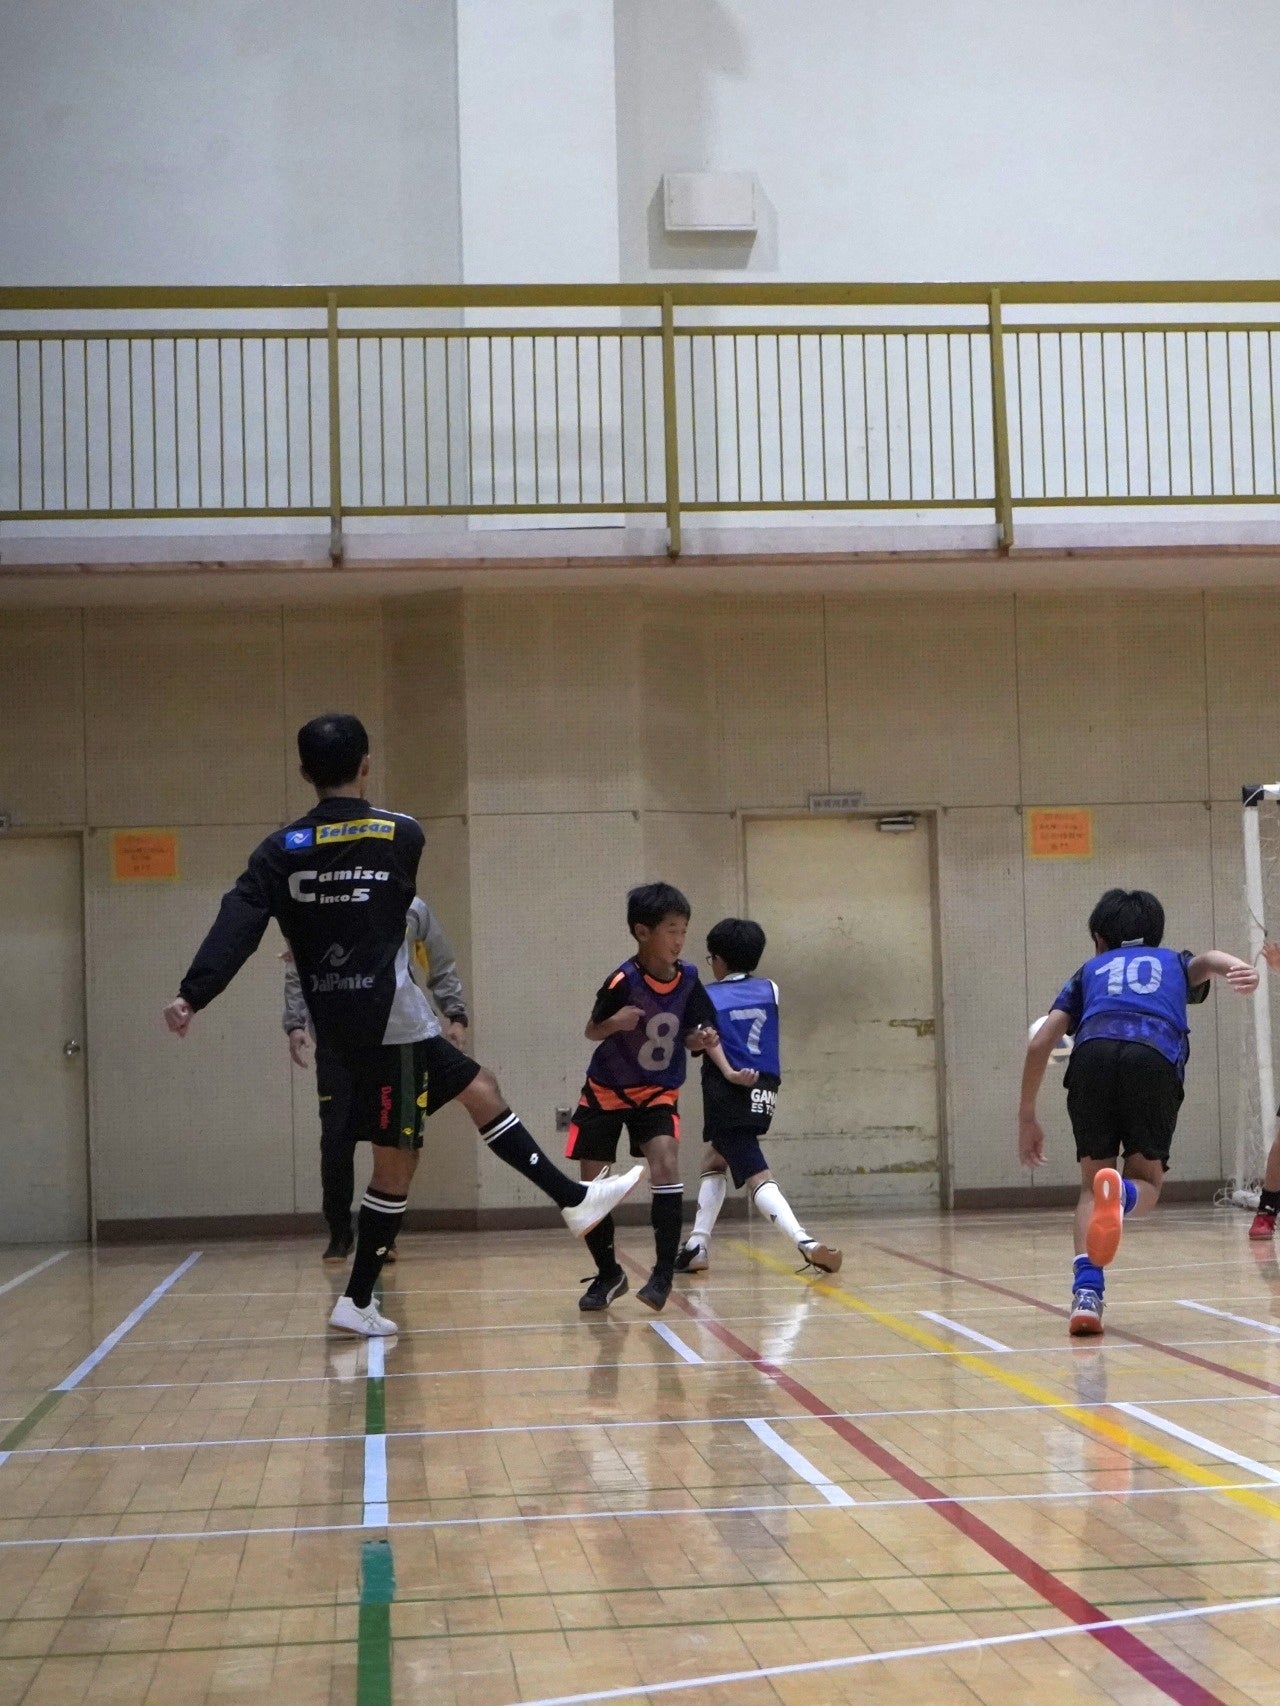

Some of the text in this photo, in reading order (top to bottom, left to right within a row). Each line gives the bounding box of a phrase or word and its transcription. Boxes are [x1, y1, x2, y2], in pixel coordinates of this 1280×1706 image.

[319, 821, 393, 839] Selecao
[1094, 955, 1163, 996] 10
[636, 1011, 681, 1071] 8
[728, 1007, 768, 1055] 7
[751, 1102, 764, 1113] ES
